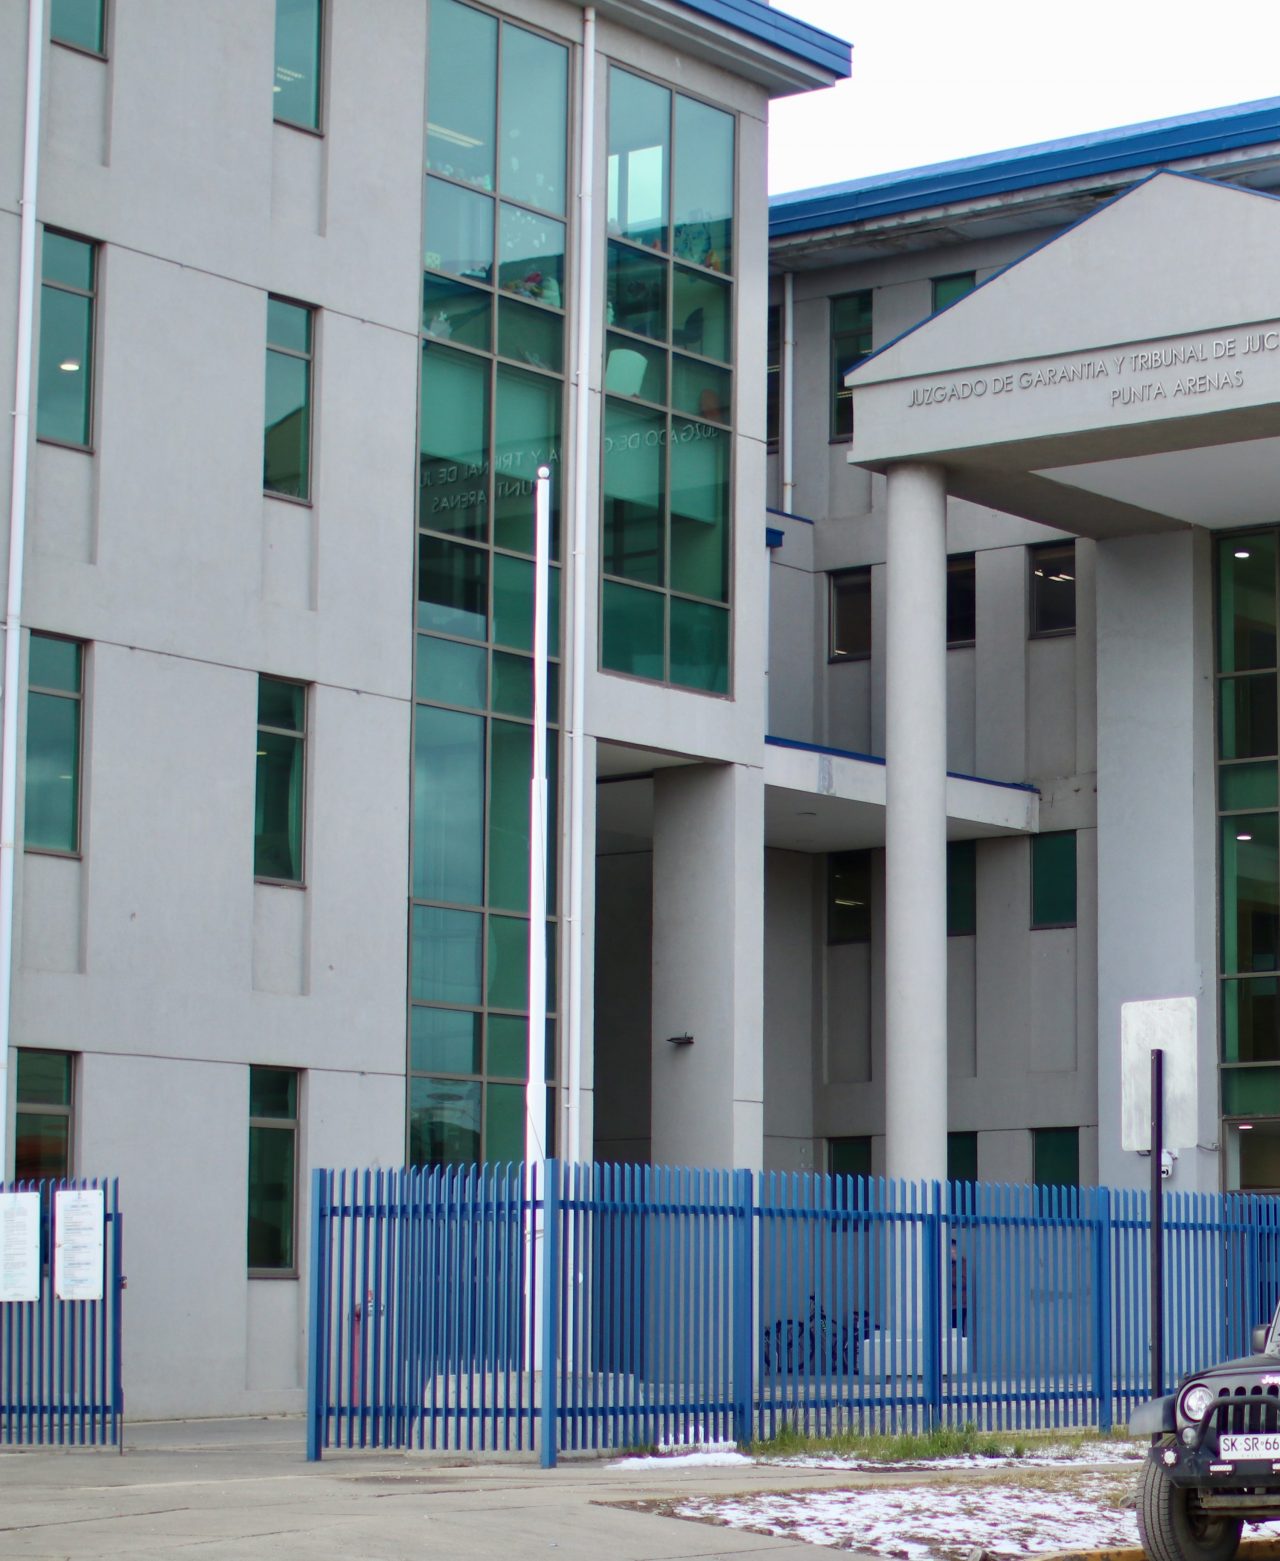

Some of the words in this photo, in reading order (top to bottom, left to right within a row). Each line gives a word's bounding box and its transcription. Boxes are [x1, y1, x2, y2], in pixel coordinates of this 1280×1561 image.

[908, 379, 988, 408] JUZGADO
[992, 374, 1014, 395] DE
[1018, 359, 1109, 390] GARANTIA
[1114, 355, 1126, 375] Y
[1130, 343, 1208, 373] TRIBUNAL
[1213, 337, 1237, 359] DE
[1110, 383, 1167, 407] PUNTA
[1173, 369, 1245, 398] ARENAS
